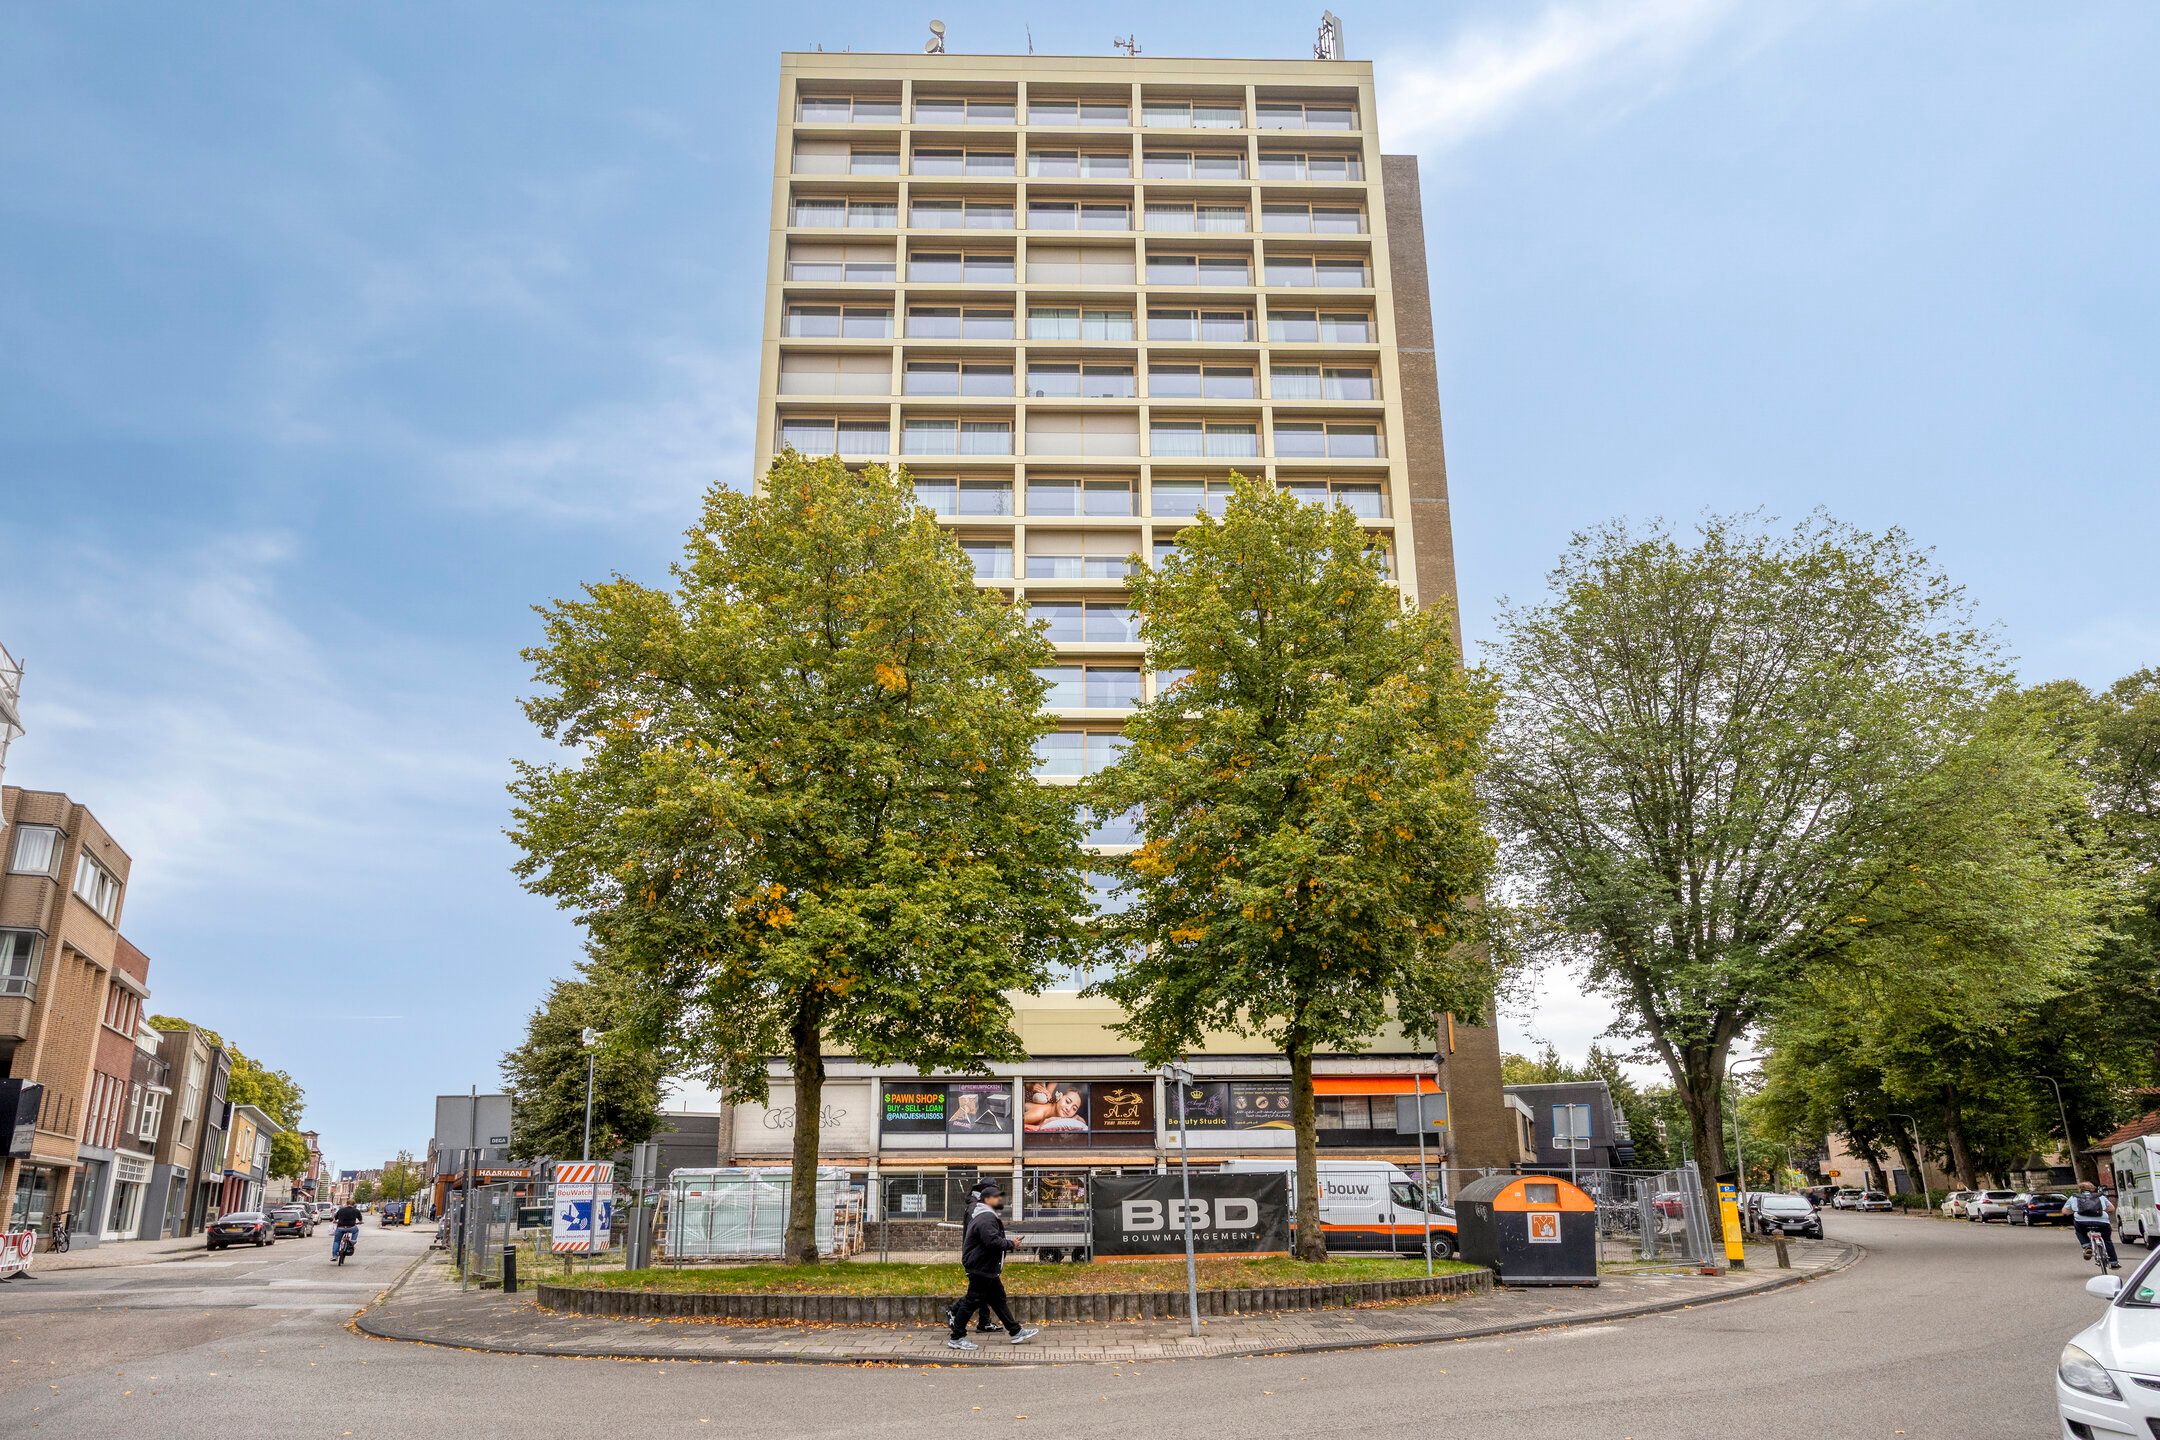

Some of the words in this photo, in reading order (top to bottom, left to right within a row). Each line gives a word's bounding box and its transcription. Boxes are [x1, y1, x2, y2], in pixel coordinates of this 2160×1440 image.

[891, 1094, 915, 1103] PAWN
[916, 1094, 938, 1103] SHOP
[763, 1104, 847, 1130] CRK
[886, 1112, 944, 1121] @PANDJESHUIS053
[1168, 1118, 1198, 1126] Beuty
[479, 1169, 523, 1177] HAARMAN
[557, 1189, 593, 1197] BouWatch
[1121, 1197, 1259, 1231] BBD
[1122, 1232, 1260, 1242] BOUWMAAGEMENT.
